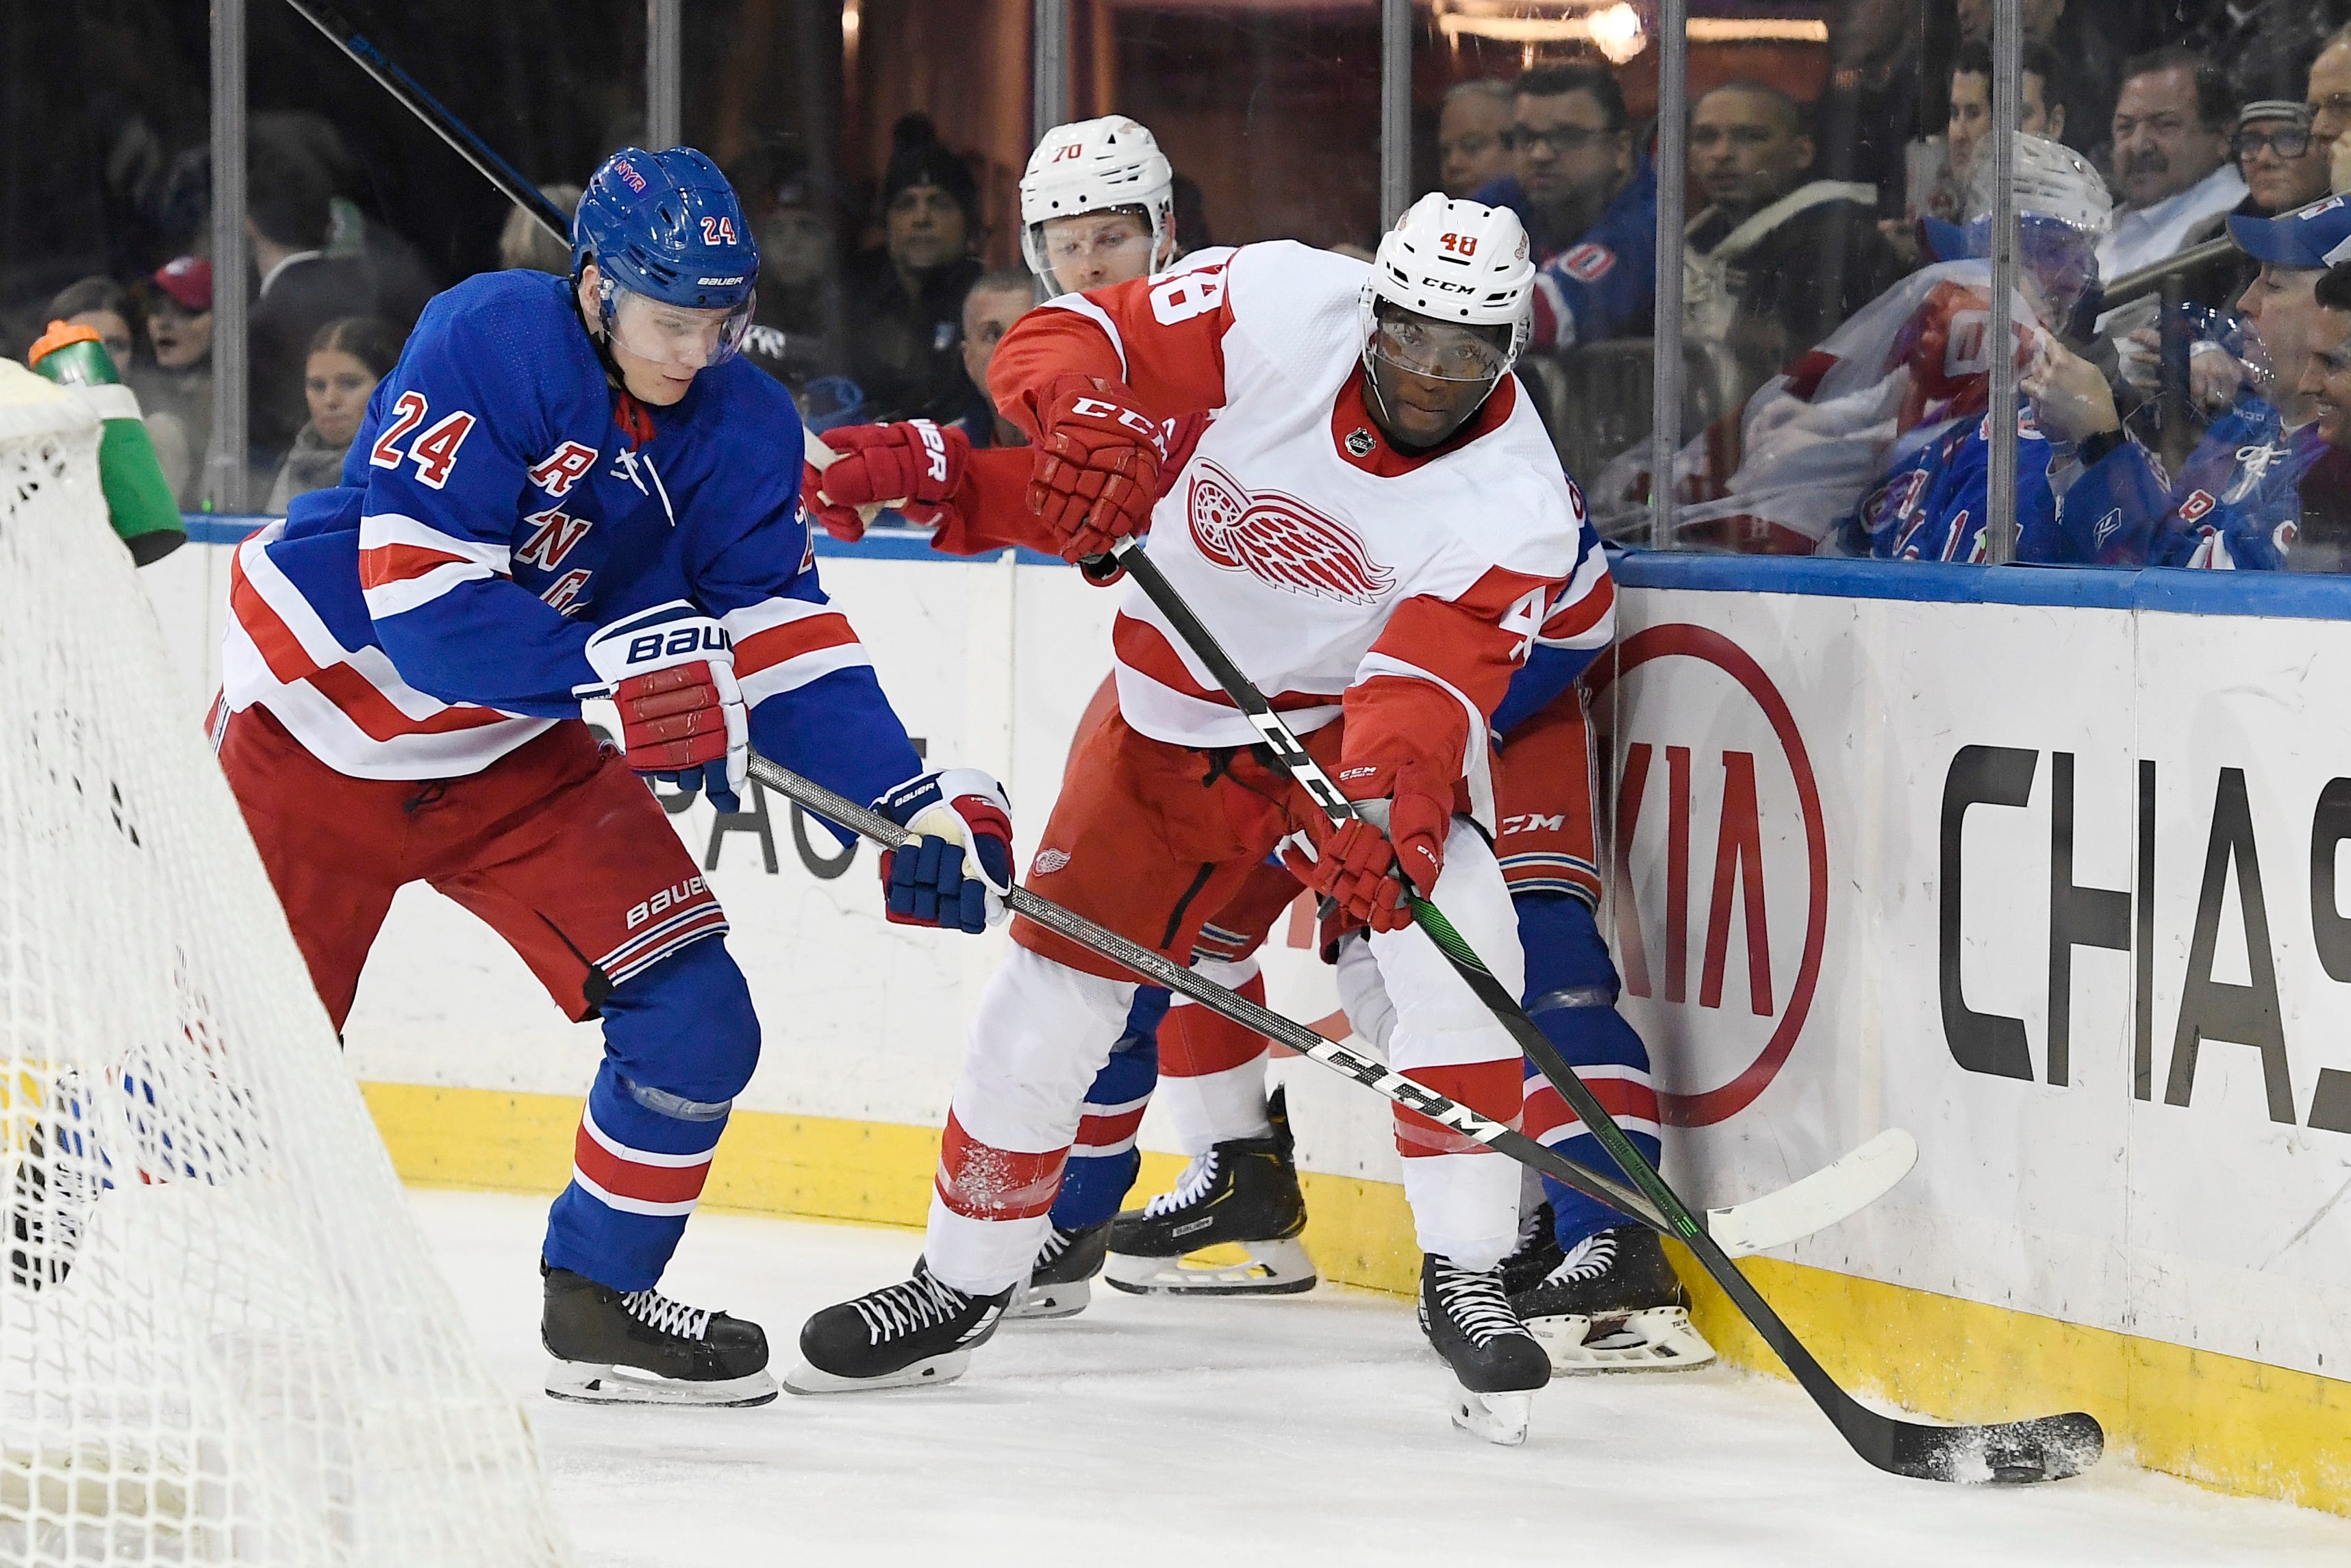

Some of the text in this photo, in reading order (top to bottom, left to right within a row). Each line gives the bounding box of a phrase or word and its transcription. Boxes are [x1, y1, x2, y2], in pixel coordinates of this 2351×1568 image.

[1052, 143, 1083, 164] 70
[614, 160, 646, 194] NYR
[700, 216, 738, 246] 24
[1439, 233, 1478, 257] 48
[697, 276, 744, 286] BAUER
[1422, 276, 1476, 295] CCM
[370, 390, 476, 490] 24
[1248, 705, 1359, 830] CC
[1339, 766, 1376, 779] CCM
[894, 782, 935, 808] BAUER
[1306, 1038, 1509, 1144] CCM
